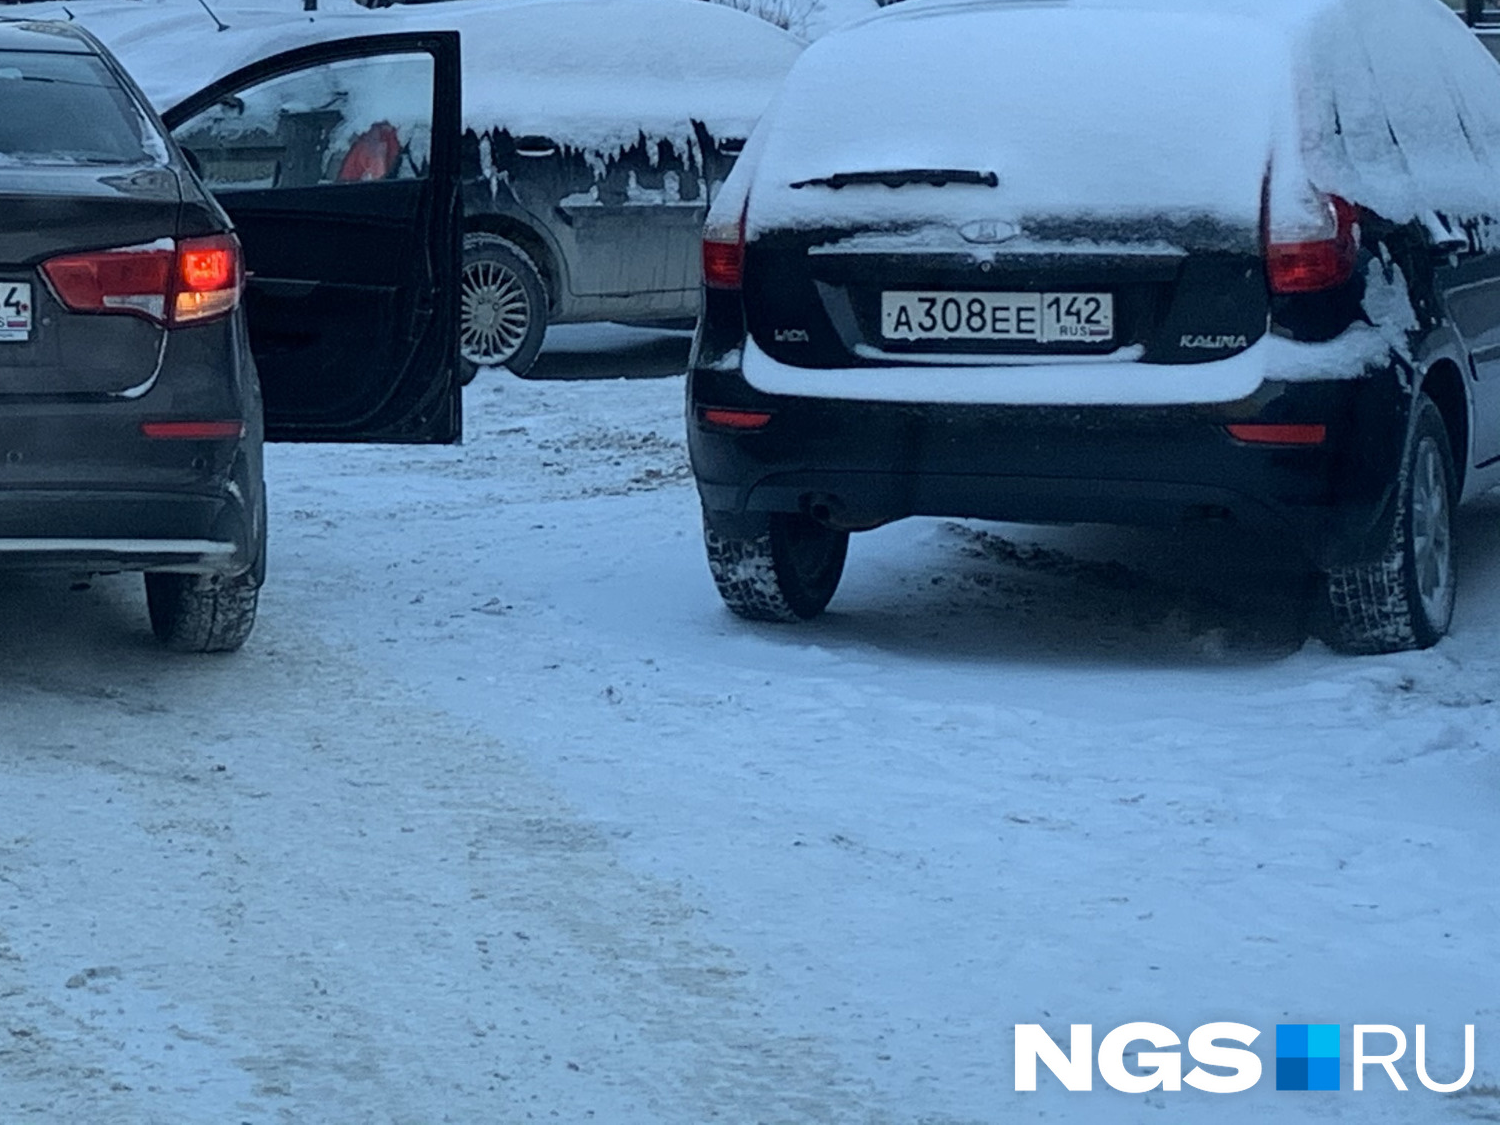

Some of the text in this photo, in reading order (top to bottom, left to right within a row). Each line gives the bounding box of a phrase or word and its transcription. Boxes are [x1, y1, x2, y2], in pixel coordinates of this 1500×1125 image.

[893, 296, 1102, 334] А308ЕЕ 142
[1059, 326, 1088, 337] RUS
[1180, 334, 1248, 348] KALINA
